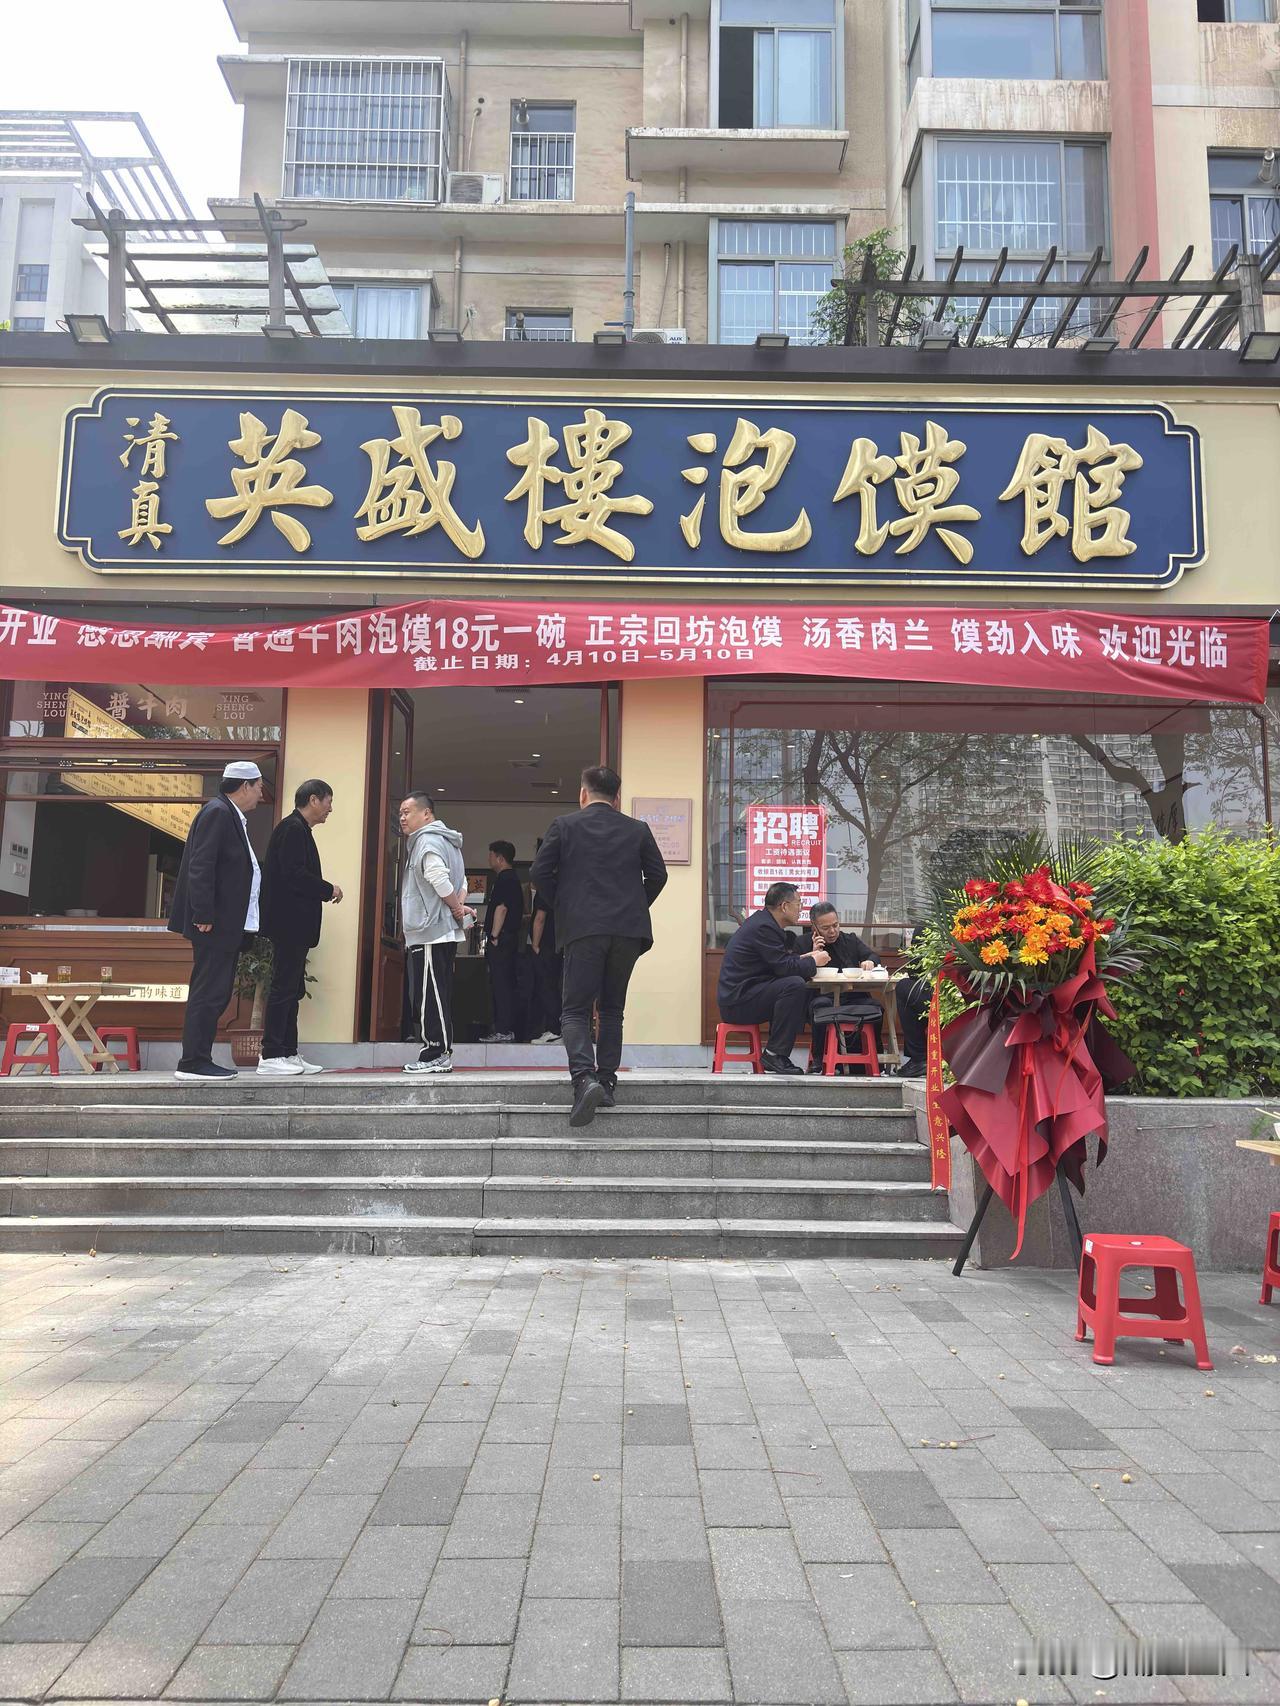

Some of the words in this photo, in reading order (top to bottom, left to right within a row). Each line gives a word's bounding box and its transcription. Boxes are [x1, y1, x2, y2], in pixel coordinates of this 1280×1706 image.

[117, 412, 178, 552] 清真
[585, 613, 784, 649] 正宗回坊泡馍
[802, 616, 934, 652] 汤香肉兰
[950, 618, 1084, 659] 馍劲入味
[1098, 624, 1229, 669] 欢迎光临
[221, 695, 249, 703] YING
[216, 703, 254, 711] SHENG
[44, 709, 66, 718] LOU
[223, 712, 246, 720] LOU
[753, 811, 819, 845] 招聘
